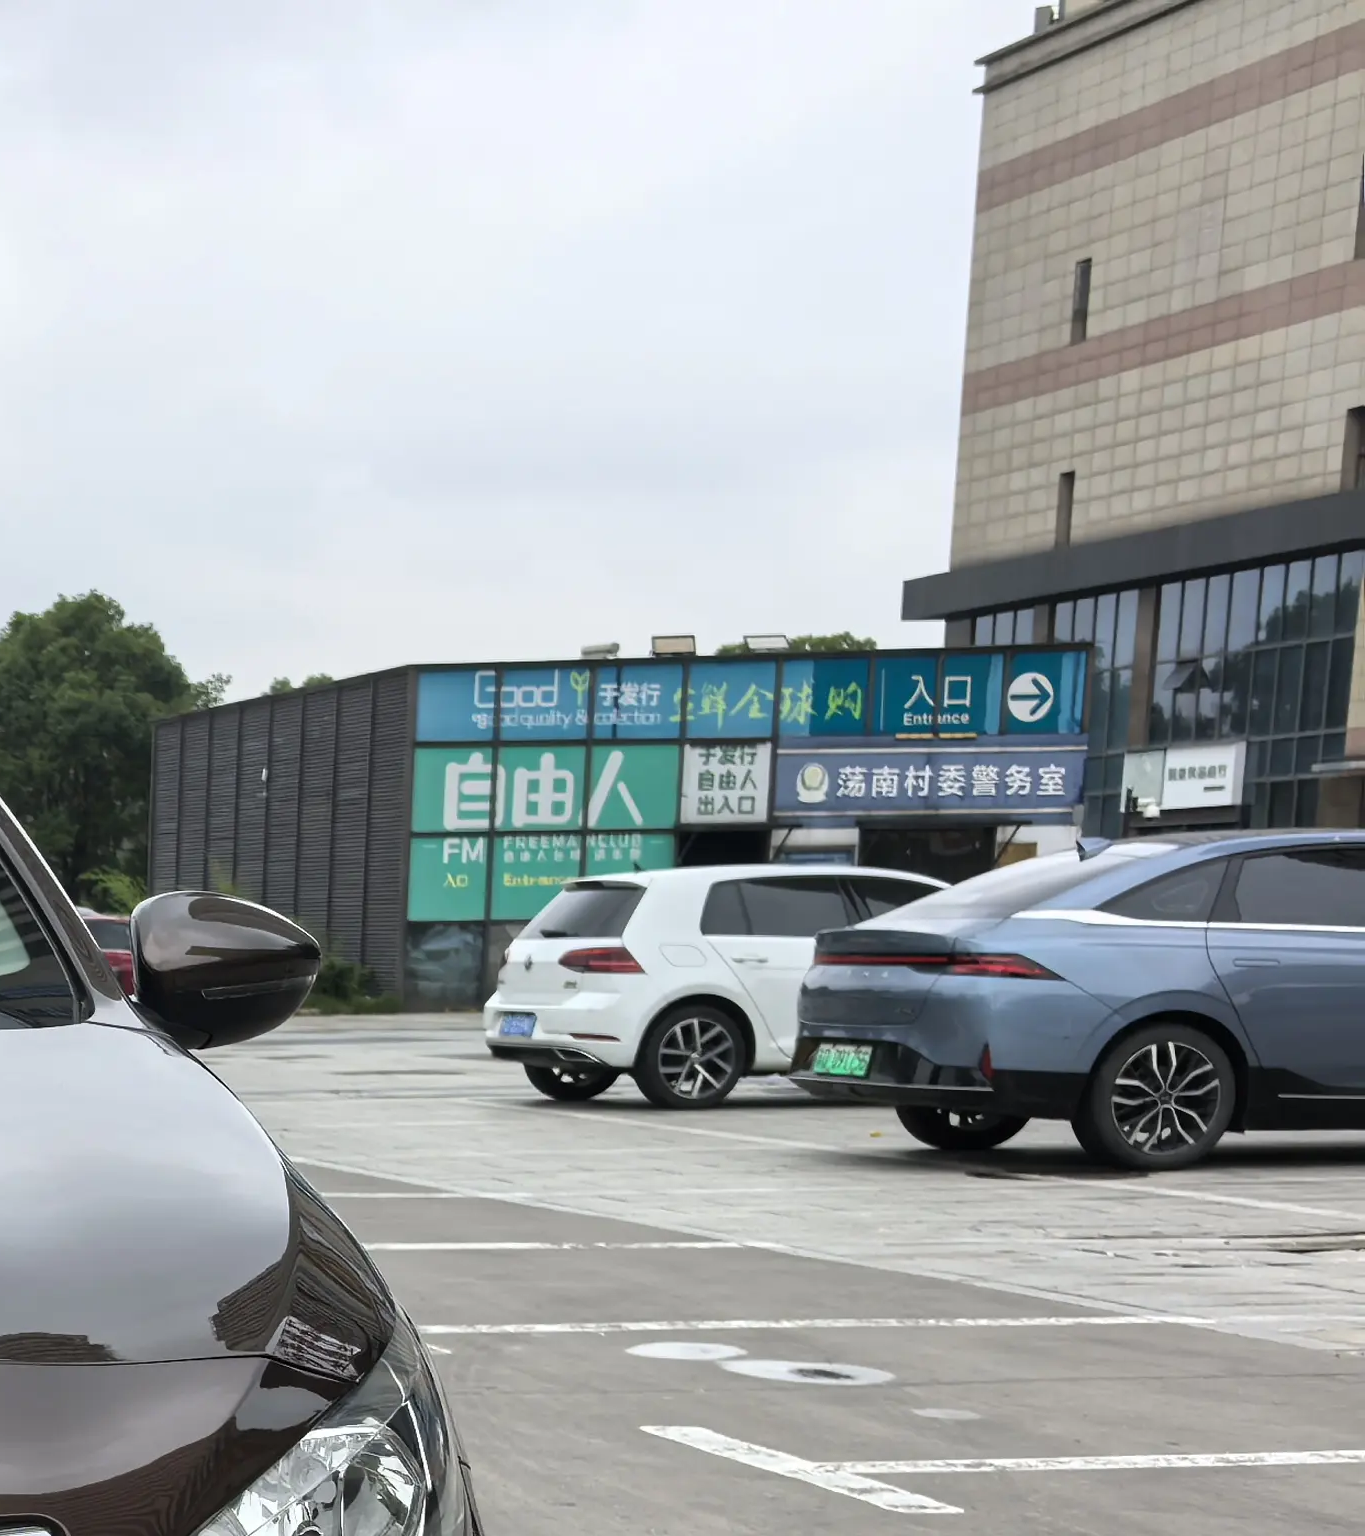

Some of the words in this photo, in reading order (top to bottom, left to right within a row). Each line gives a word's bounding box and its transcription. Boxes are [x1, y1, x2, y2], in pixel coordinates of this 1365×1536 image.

[904, 675, 971, 708] 入口
[903, 712, 970, 726] Entrance
[443, 750, 644, 831] 自由人
[698, 769, 758, 791] 自由人
[697, 796, 756, 816] 出入口
[443, 837, 484, 864] FM
